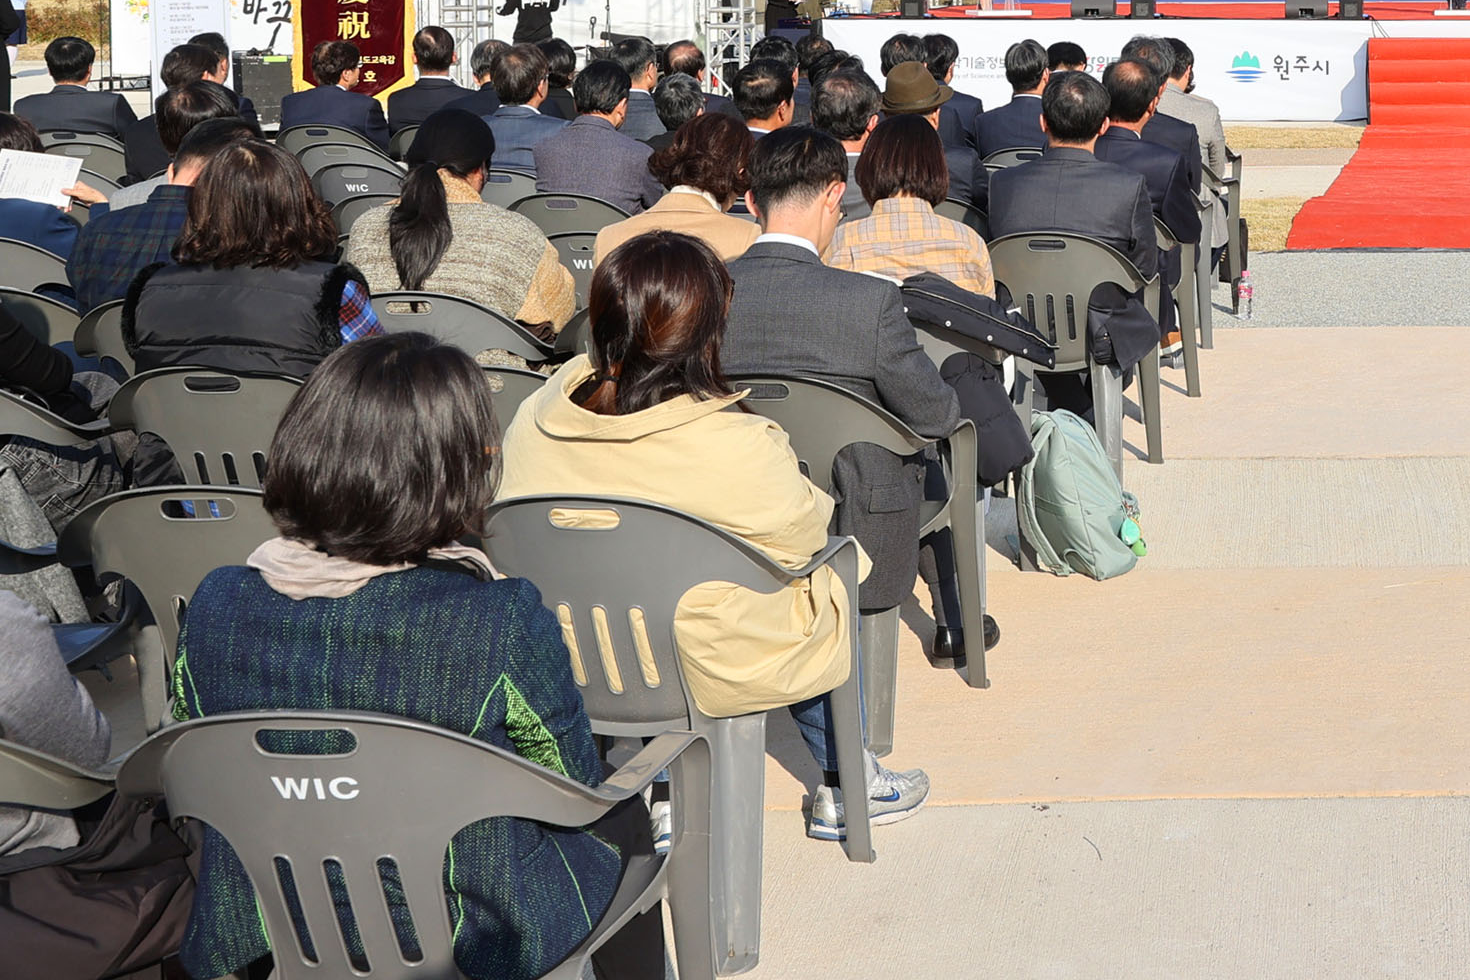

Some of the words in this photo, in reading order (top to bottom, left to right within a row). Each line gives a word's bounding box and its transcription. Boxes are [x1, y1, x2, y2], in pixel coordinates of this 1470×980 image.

[359, 54, 396, 65] 도교육감
[1273, 54, 1329, 81] 원주시
[363, 70, 377, 83] 호
[345, 183, 369, 192] WIC
[572, 259, 593, 270] WI
[270, 776, 360, 800] WIC
